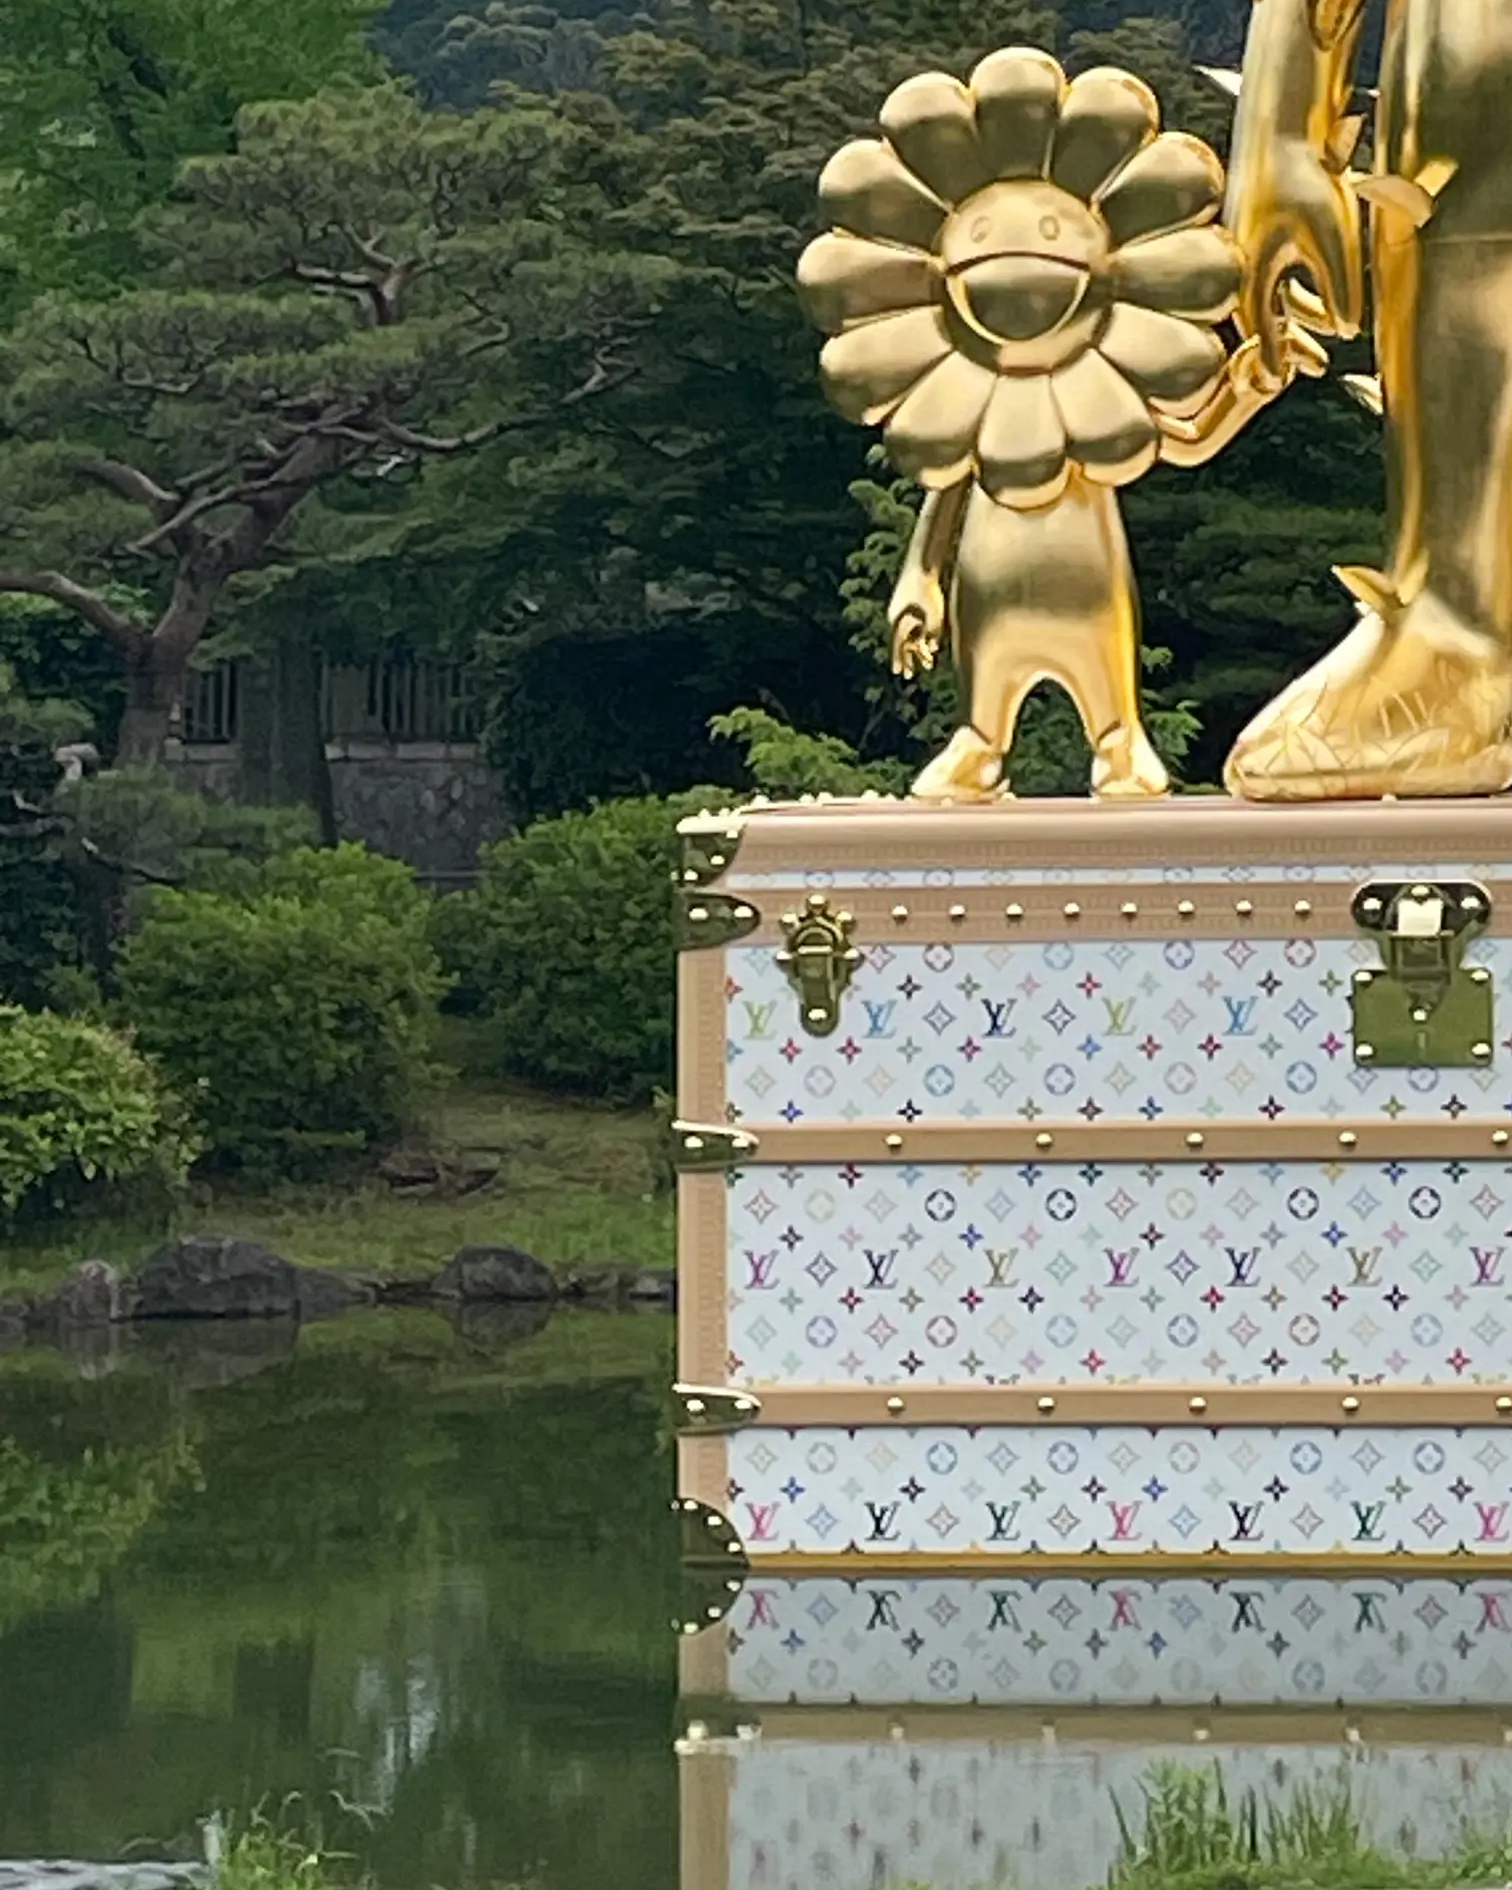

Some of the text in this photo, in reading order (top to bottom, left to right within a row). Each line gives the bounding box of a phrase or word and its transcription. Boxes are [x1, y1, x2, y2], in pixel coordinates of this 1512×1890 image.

[742, 1000, 777, 1040] LV
[861, 1000, 897, 1039] LV
[981, 999, 1016, 1037] LV
[1101, 996, 1137, 1036] LV
[1222, 996, 1258, 1036] LV
[744, 1250, 779, 1290] LV
[864, 1250, 898, 1289] LV
[984, 1248, 1019, 1288] LV
[1104, 1248, 1139, 1287] LV
[1224, 1247, 1260, 1287] LV
[1346, 1247, 1383, 1287] LV
[1469, 1247, 1505, 1286] LV
[745, 1502, 780, 1541] LV
[865, 1502, 900, 1541] LV
[985, 1501, 1020, 1541] LV
[1106, 1501, 1142, 1541] LV
[1229, 1501, 1263, 1541] LV
[1351, 1501, 1385, 1541] LV
[1473, 1502, 1509, 1542] LV
